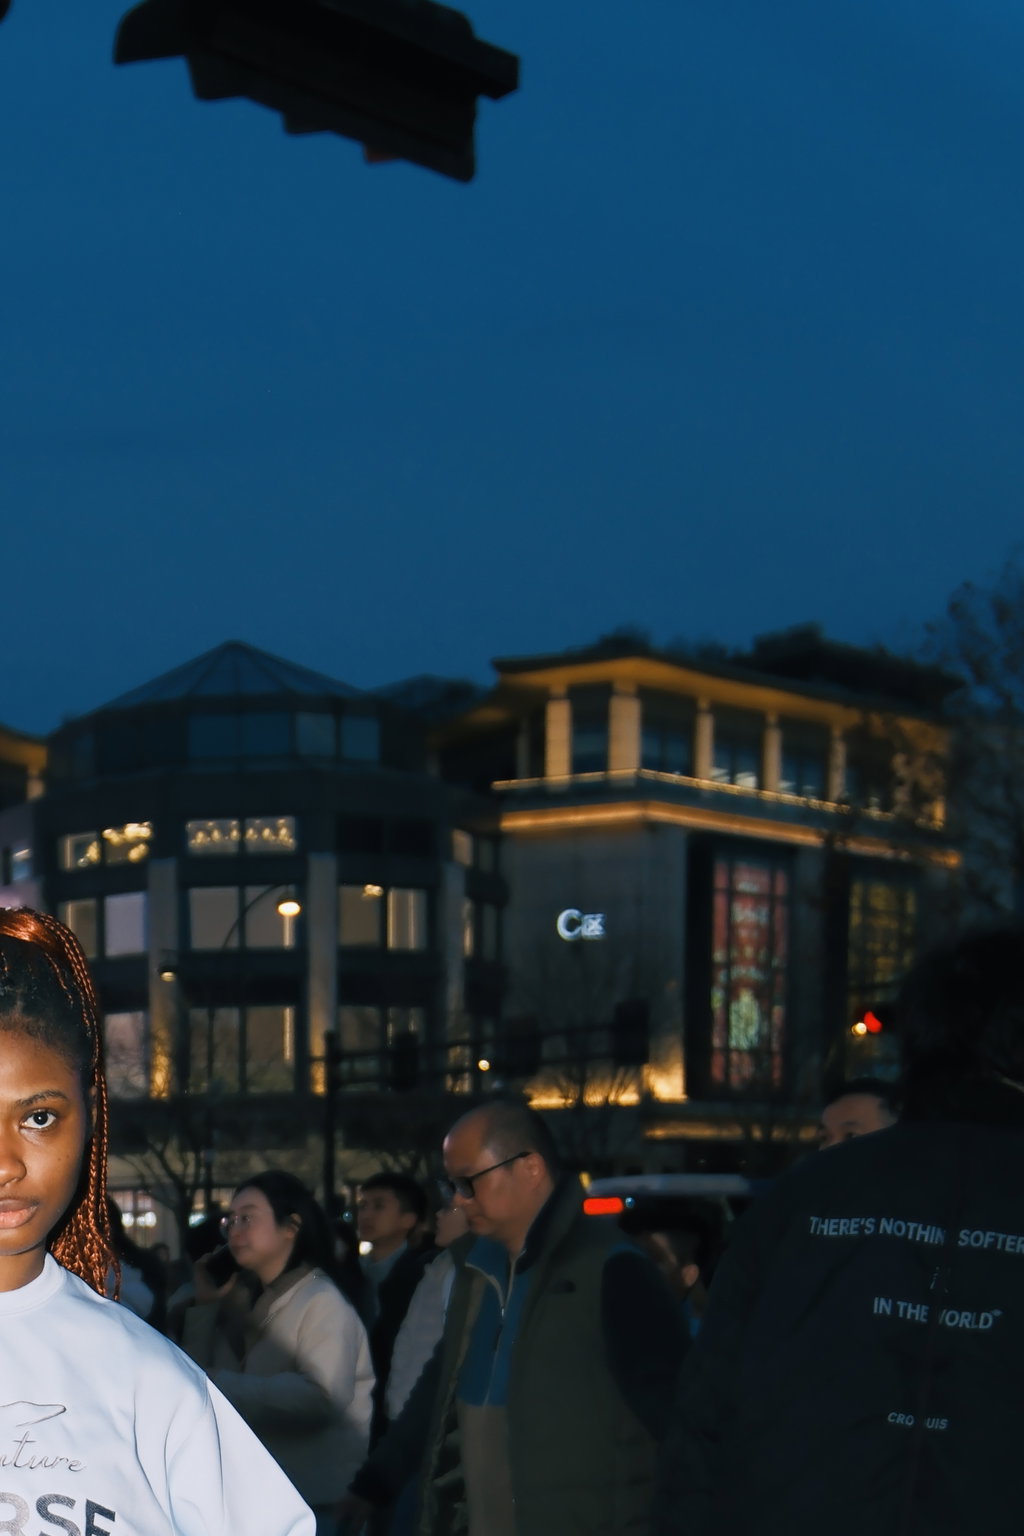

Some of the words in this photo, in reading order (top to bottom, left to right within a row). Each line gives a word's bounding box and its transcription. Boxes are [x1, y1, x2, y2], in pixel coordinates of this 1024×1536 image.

[808, 1216, 876, 1236] THERE'S
[879, 1217, 948, 1246] NOTHIN
[873, 1297, 892, 1316] IN
[896, 1300, 930, 1322] THE
[938, 1308, 994, 1330] ORLD
